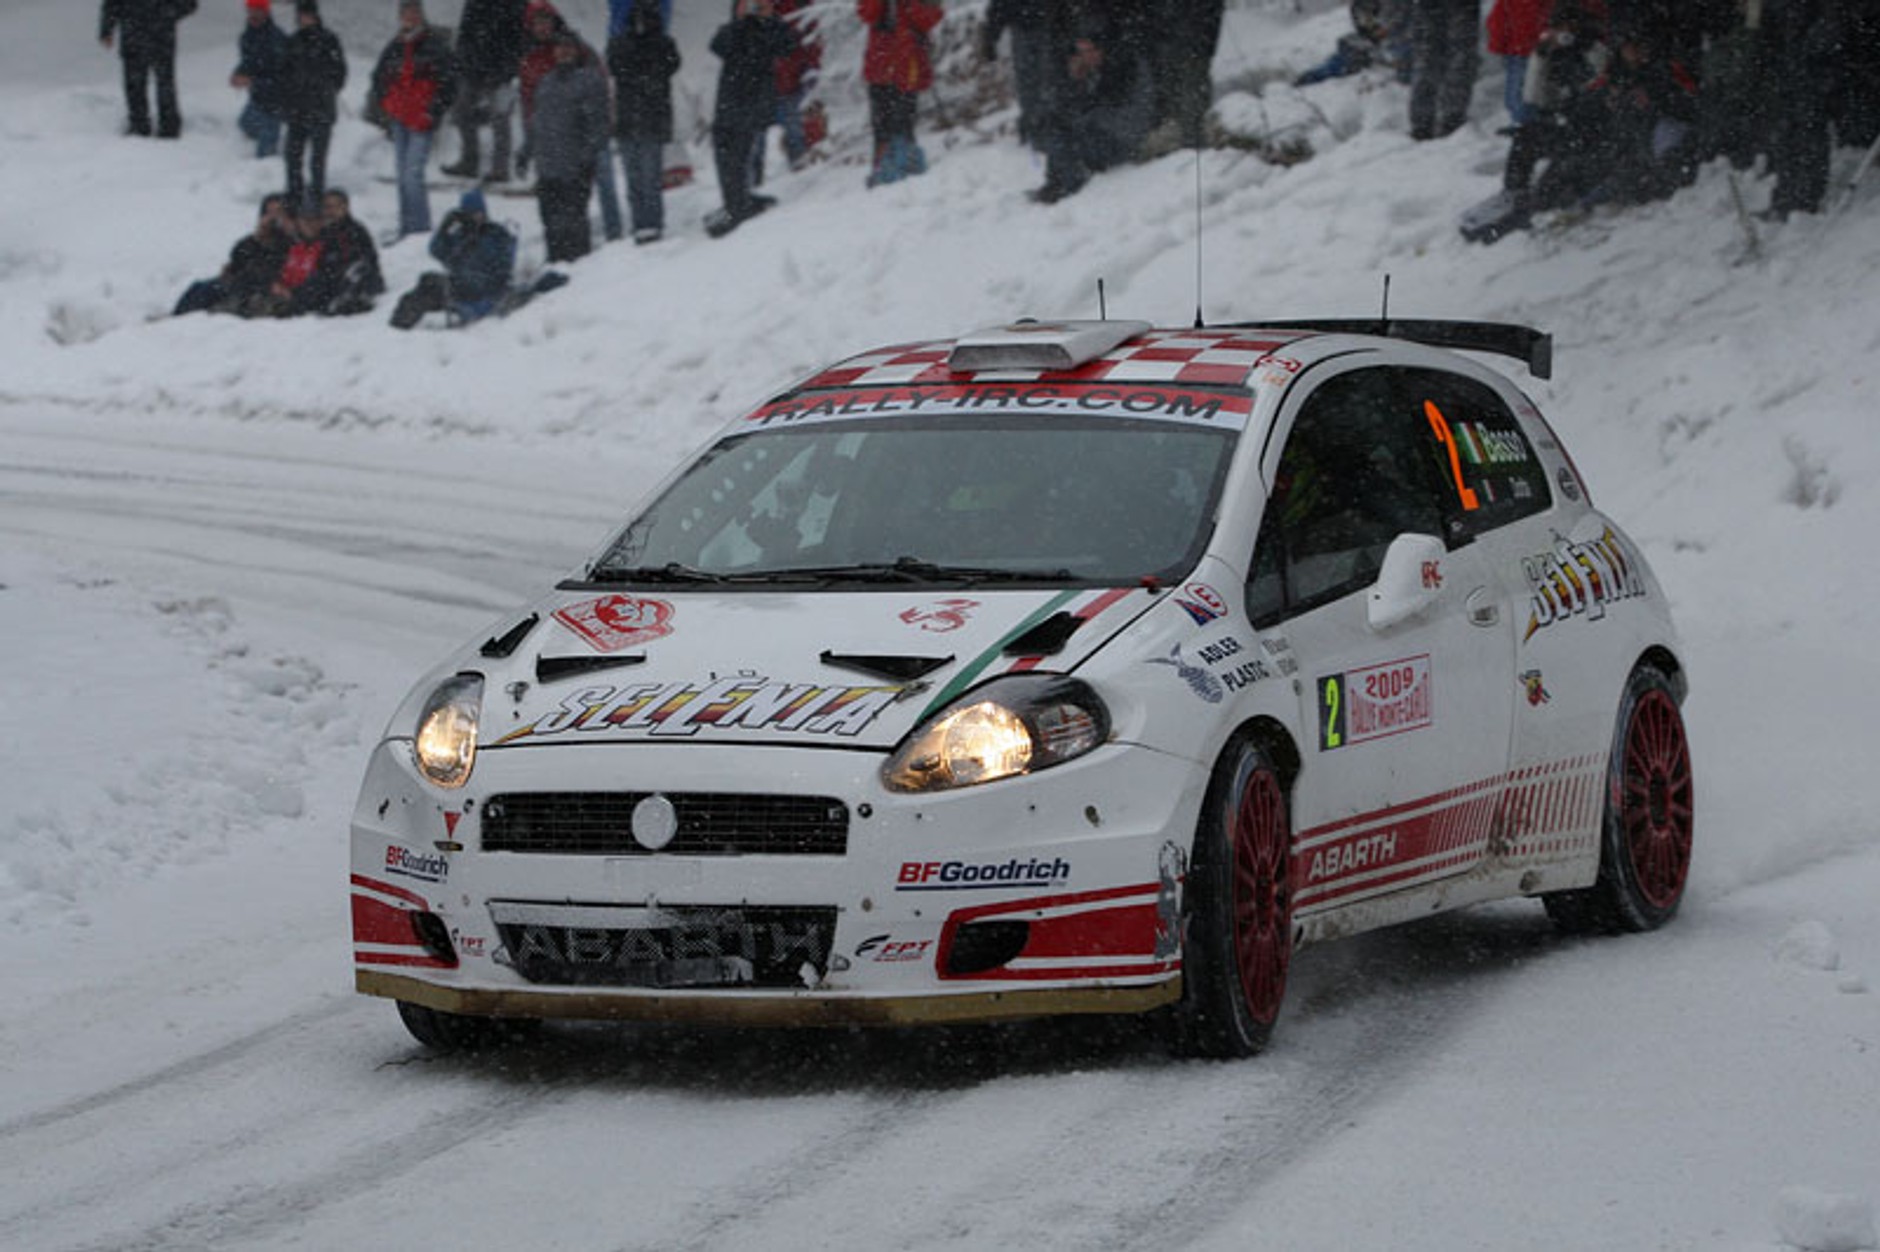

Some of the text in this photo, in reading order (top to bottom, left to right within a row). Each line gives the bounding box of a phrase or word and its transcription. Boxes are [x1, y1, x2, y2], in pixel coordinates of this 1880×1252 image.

[761, 388, 1222, 424] RALLY-IRC.COM
[1424, 399, 1480, 511] 2
[1476, 421, 1528, 463] Basso
[1198, 637, 1244, 665] ADLER
[1221, 660, 1270, 693] PLASTIC
[1366, 667, 1413, 699] 2009
[1325, 677, 1341, 749] 2
[386, 845, 449, 876] BFGoodrich
[897, 858, 1070, 882] BFGoodrich
[1308, 830, 1398, 881] ABARTH
[513, 924, 825, 964] ABARTH
[882, 940, 932, 953] FPT
